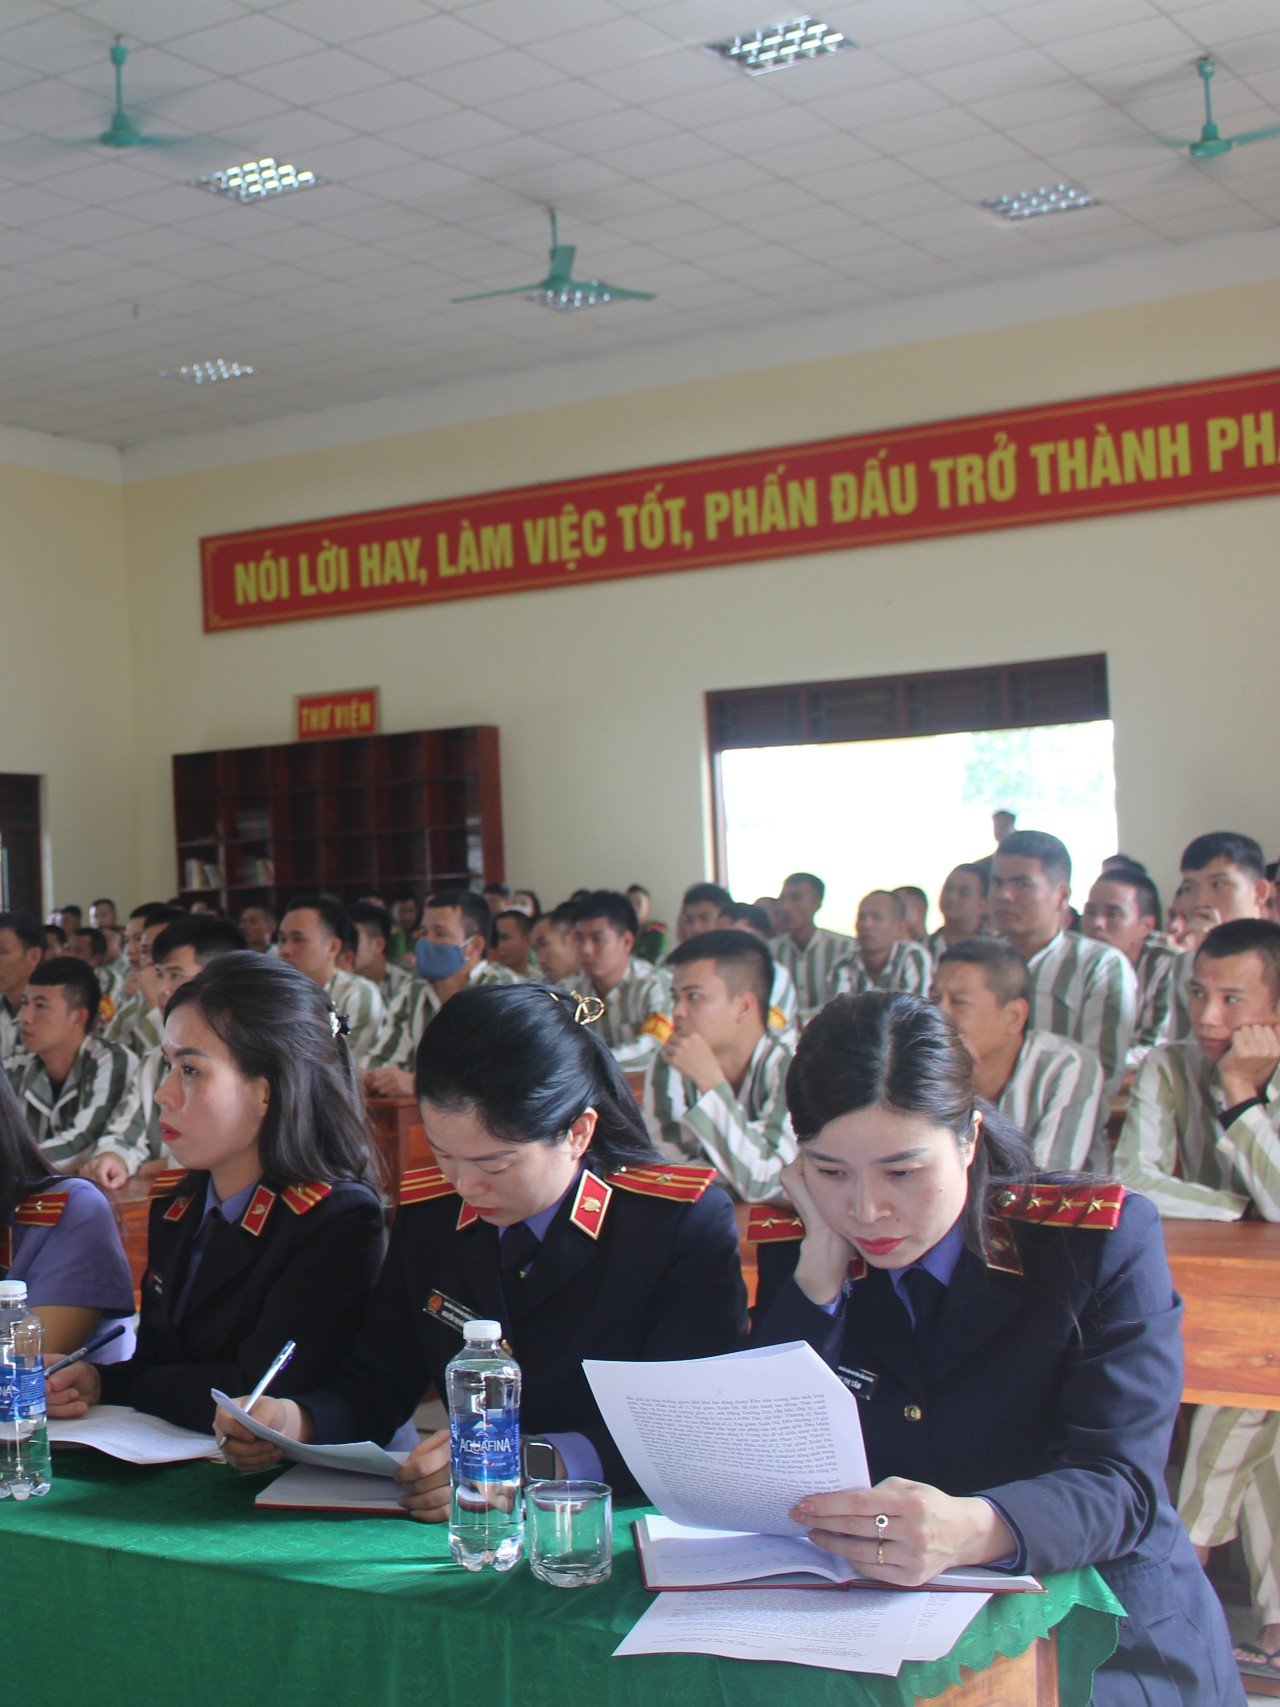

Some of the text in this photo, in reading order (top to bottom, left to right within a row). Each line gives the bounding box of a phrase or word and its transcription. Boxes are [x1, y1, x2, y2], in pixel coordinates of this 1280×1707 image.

[235, 412, 1280, 603] NÓI LỜI HAY, LÀM VIỆC TỐT, PHẤN ĐẤU TRỞ THÀNH PH
[459, 1438, 512, 1454] AQUAFINA
